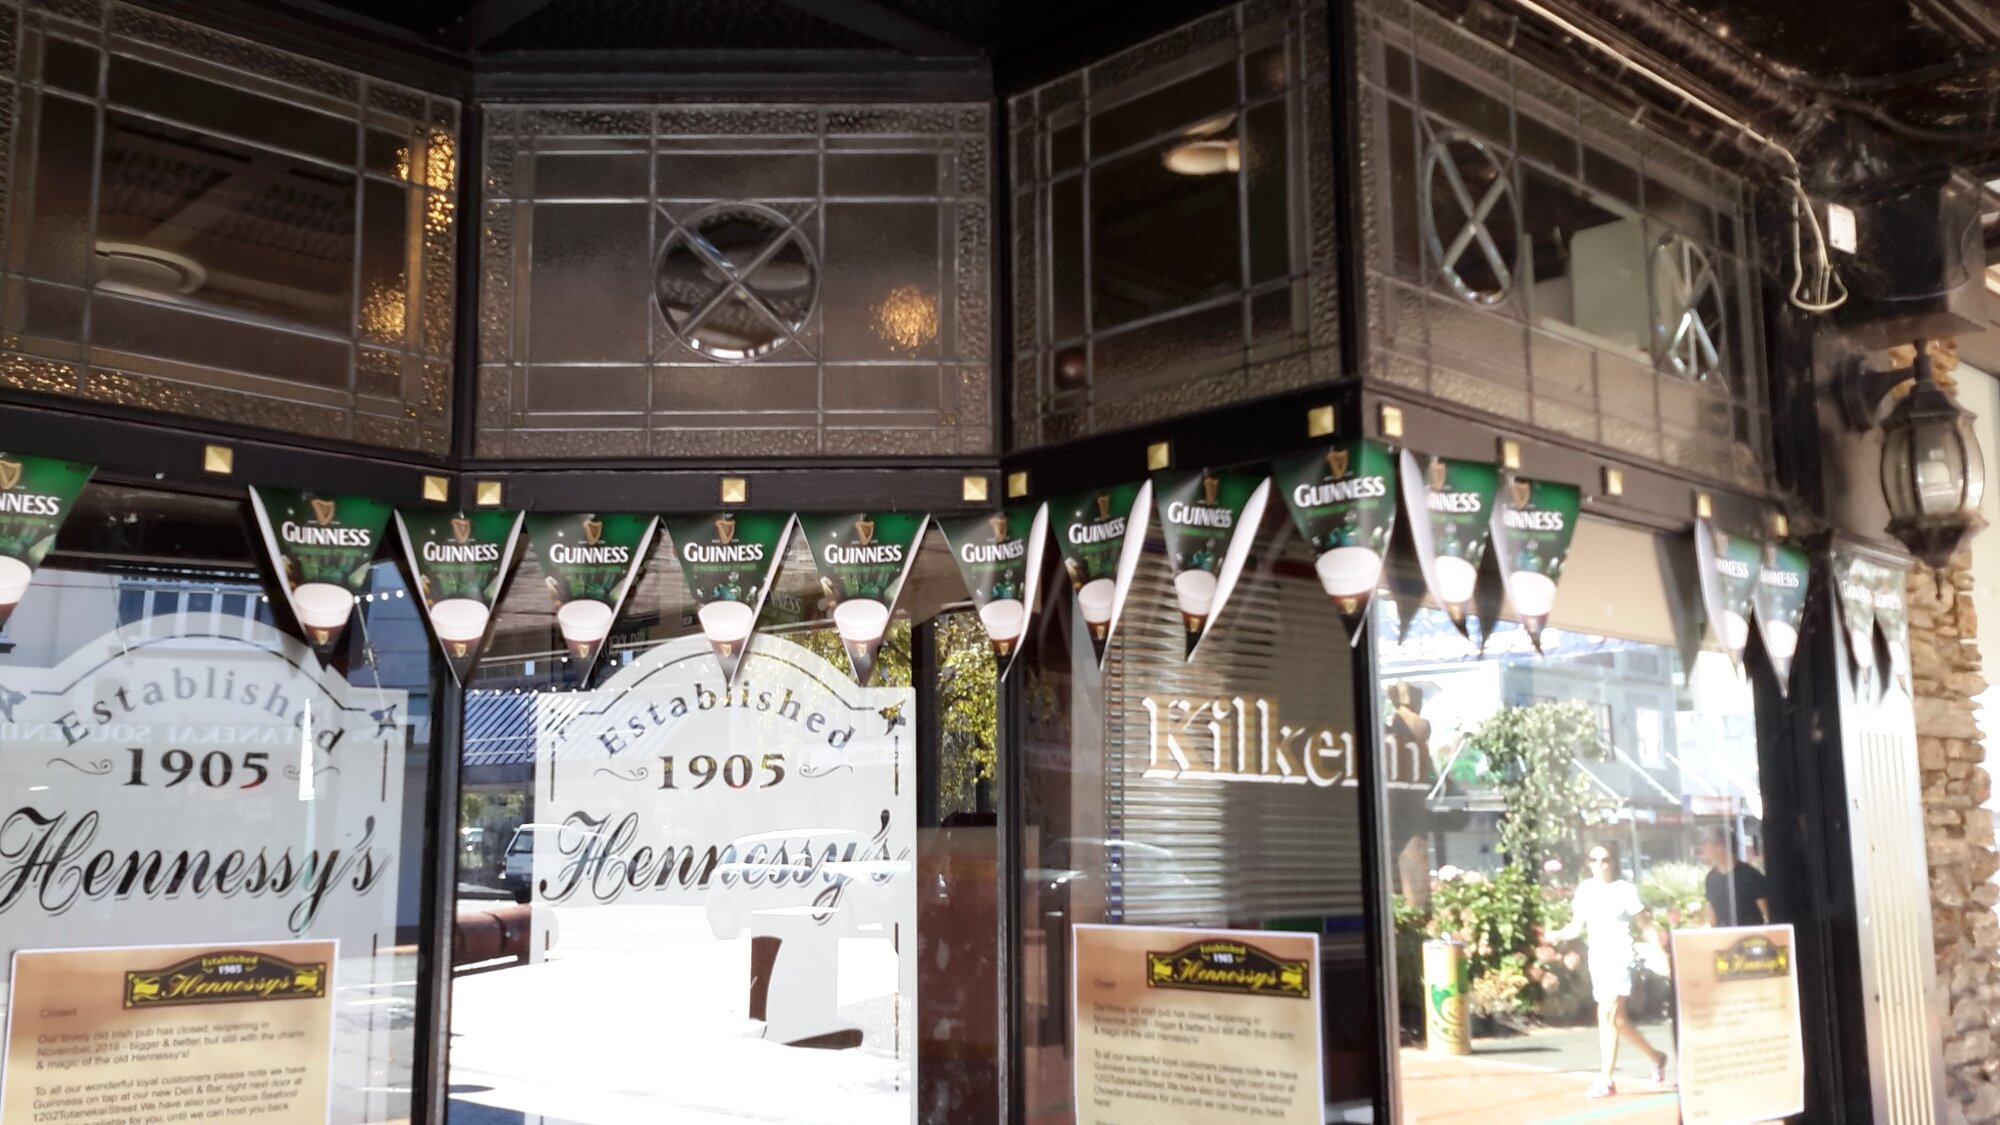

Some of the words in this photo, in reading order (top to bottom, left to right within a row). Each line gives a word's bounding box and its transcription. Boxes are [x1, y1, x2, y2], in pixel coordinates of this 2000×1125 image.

[1294, 476, 1386, 508] GUINNESS
[1167, 500, 1233, 528] GUINNESS
[281, 521, 371, 547] GUINNESS
[1068, 517, 1126, 545] GUINNESS
[423, 540, 499, 563] GUINNESS
[549, 542, 629, 564] GUINNESS
[684, 541, 764, 563] GUINNESS
[824, 542, 902, 564] GUINNESS
[961, 539, 1024, 563] GUINNESS
[53, 667, 346, 756] Established
[599, 681, 857, 760] Established
[123, 748, 270, 789] 1905
[656, 753, 786, 790] 1905
[0, 806, 391, 936] Hennessy's
[539, 808, 911, 926] Hennessy's
[218, 964, 243, 975] 1905
[93, 1030, 108, 1040] old
[136, 1028, 153, 1039] pub
[157, 1027, 173, 1036] has
[261, 1022, 269, 1030] in
[129, 1041, 159, 1051] bigger
[162, 1038, 170, 1048] &
[204, 1036, 219, 1045] but
[240, 1032, 258, 1042] with
[261, 1031, 274, 1040] the
[36, 1060, 43, 1070] &
[47, 1060, 77, 1070] magic
[82, 1057, 92, 1066] of
[95, 1057, 110, 1066] the
[112, 1054, 128, 1064] old
[33, 1098, 82, 1110] Guinness
[86, 1096, 99, 1105] on
[102, 1094, 118, 1104] tap
[120, 1092, 130, 1101] at
[133, 1092, 150, 1100] our
[152, 1090, 172, 1098] new
[175, 1086, 194, 1096] Deli
[196, 1085, 203, 1094] &
[226, 1082, 247, 1093] right
[249, 1080, 269, 1089] next
[270, 1079, 291, 1088] door
[293, 1078, 302, 1086] at
[35, 1086, 46, 1096] To
[50, 1085, 61, 1095] all
[64, 1085, 81, 1094] our
[85, 1079, 133, 1091] wonderful
[136, 1078, 158, 1089] loyal
[161, 1074, 211, 1085] customers
[214, 1071, 245, 1081] please
[247, 1070, 267, 1078] note
[285, 1067, 306, 1075] have
[140, 1102, 156, 1111] We
[159, 1100, 181, 1109] have
[184, 1099, 204, 1108] also
[206, 1097, 222, 1105] our
[225, 1094, 258, 1104] famous
[261, 1089, 298, 1101] Seafood
[129, 1117, 143, 1125] for
[167, 1112, 187, 1121] until
[206, 1109, 224, 1118] can
[226, 1107, 247, 1116] host
[249, 1106, 265, 1116] you
[268, 1103, 288, 1113] back
